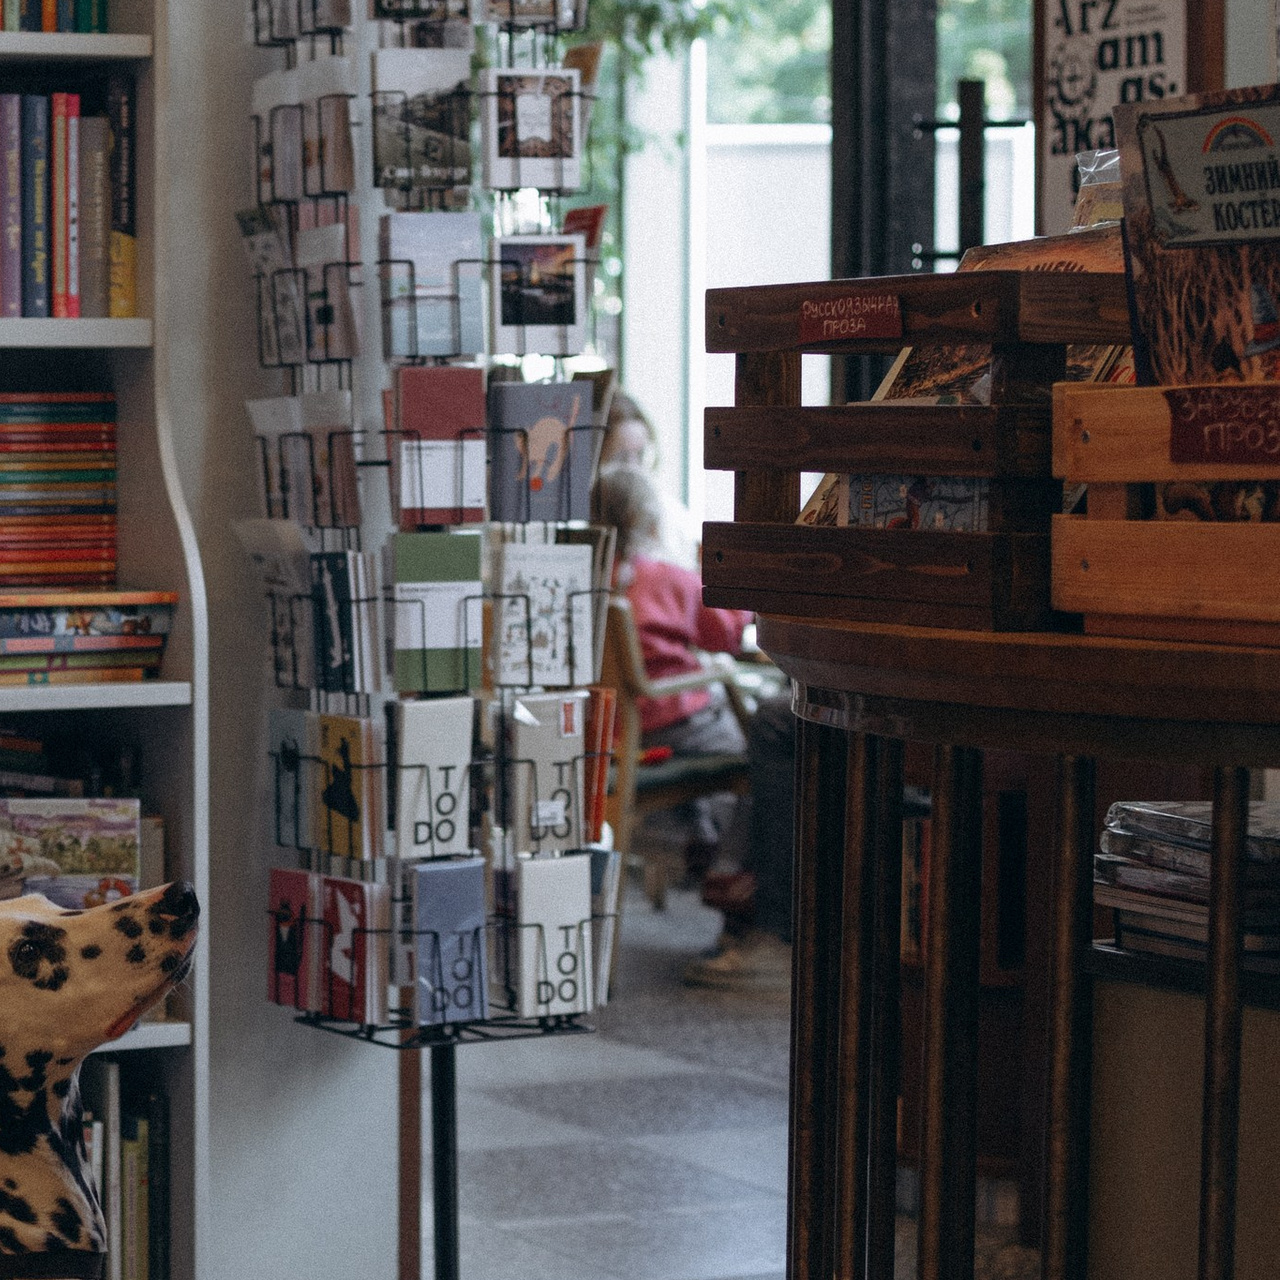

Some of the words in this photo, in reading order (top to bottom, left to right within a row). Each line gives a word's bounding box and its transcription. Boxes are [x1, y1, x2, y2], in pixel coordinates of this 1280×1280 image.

[1097, 31, 1164, 71] am
[1203, 154, 1280, 195] ЗИМНИЙ
[802, 295, 899, 320] РУССКОЯЗЫЧНАЯ
[823, 317, 866, 336] ПРОЗА
[1203, 420, 1280, 455] ПРОЗ
[413, 818, 456, 845] DO
[536, 978, 578, 1006] DO
